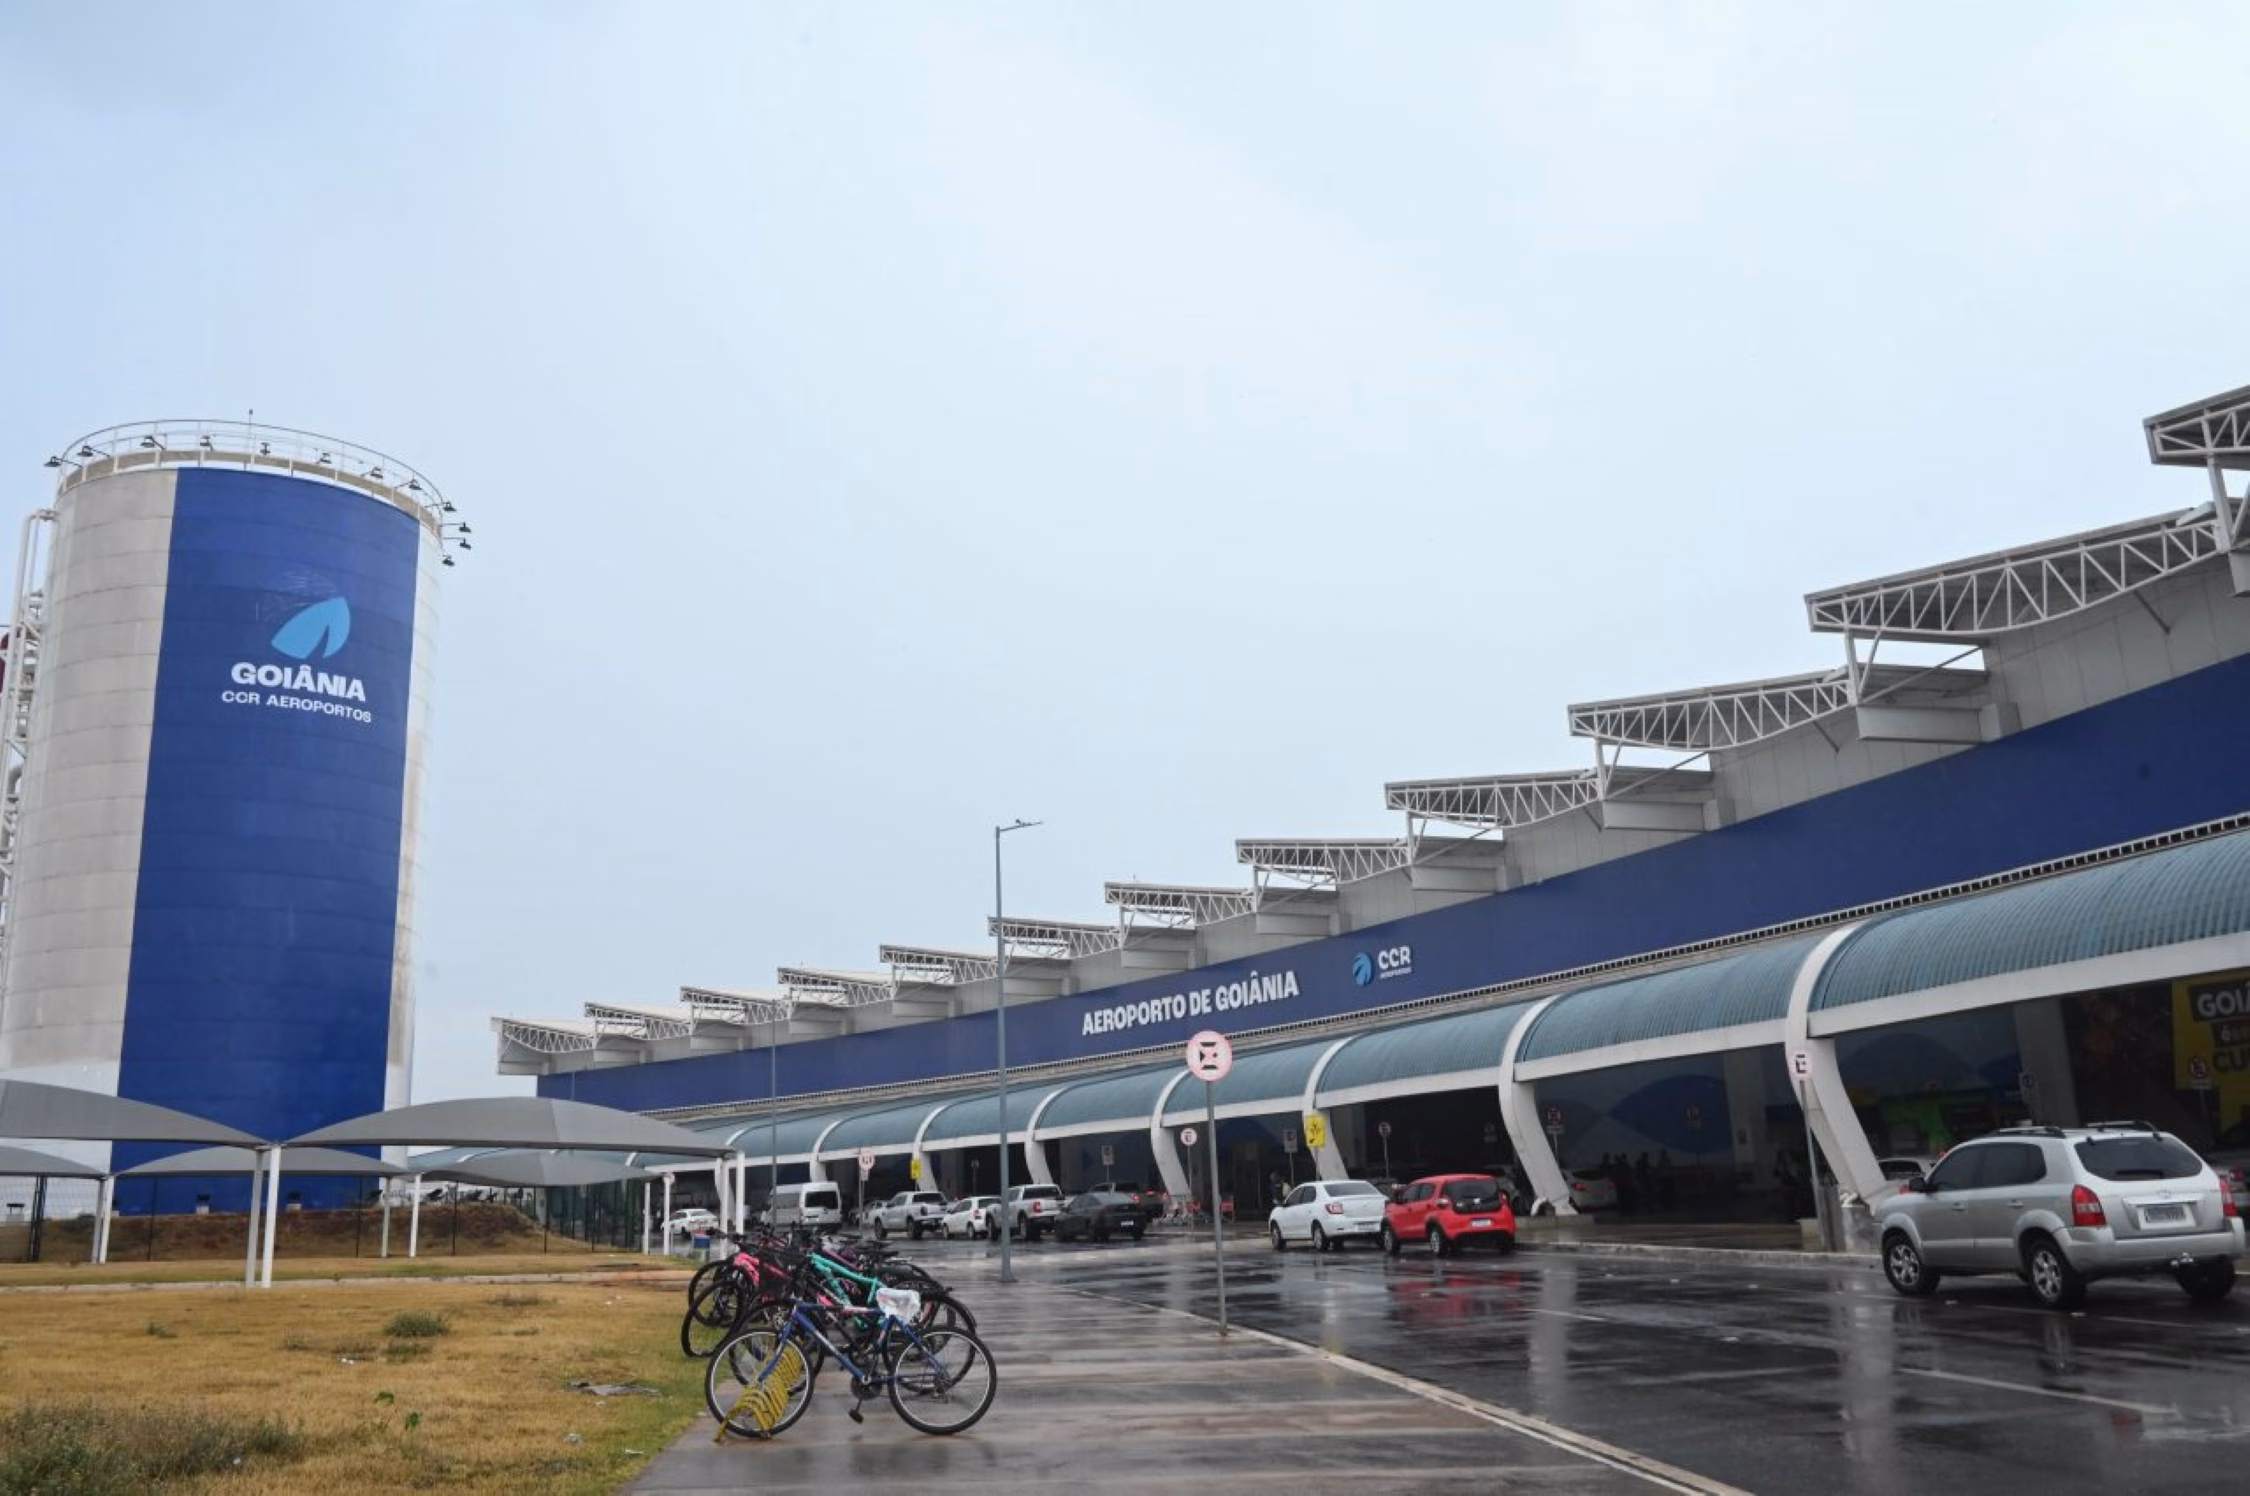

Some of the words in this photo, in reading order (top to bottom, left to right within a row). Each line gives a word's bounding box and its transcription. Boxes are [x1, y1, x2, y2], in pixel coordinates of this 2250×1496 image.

[231, 662, 366, 702] GOIÂNIA
[221, 690, 260, 704] CCR
[266, 695, 372, 722] AEROPORTOS
[1378, 945, 1412, 972] CCR
[1082, 992, 1186, 1036] AEROPORTO
[1188, 989, 1213, 1017] DE
[1215, 970, 1299, 1012] GOIÂNIA
